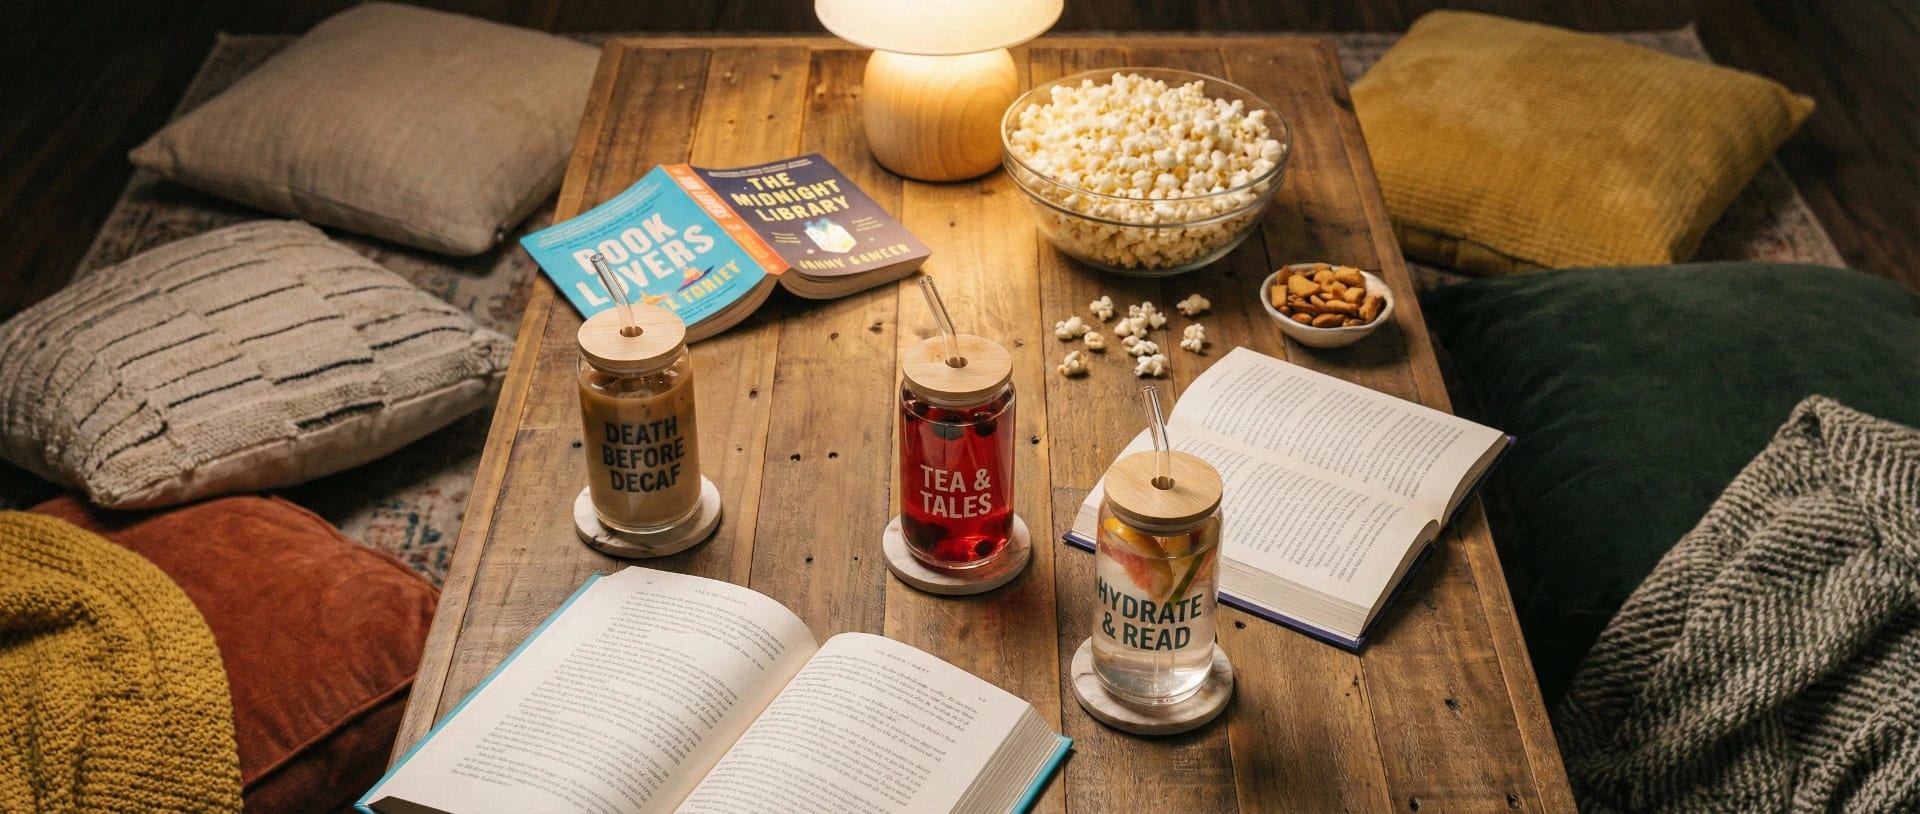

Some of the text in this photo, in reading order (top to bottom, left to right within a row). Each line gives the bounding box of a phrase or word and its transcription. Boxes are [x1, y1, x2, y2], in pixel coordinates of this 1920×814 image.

[730, 179, 840, 207] MIDNIGHT
[747, 172, 796, 191] THE
[755, 195, 849, 221] LIBRARY
[605, 415, 678, 445] DEATH
[602, 436, 685, 469] BEFORE
[610, 463, 681, 493] DECAF
[920, 463, 992, 493] TEA &
[919, 489, 992, 519] TALES
[1098, 575, 1203, 625] HYDRATE
[1102, 611, 1191, 651] & READ
